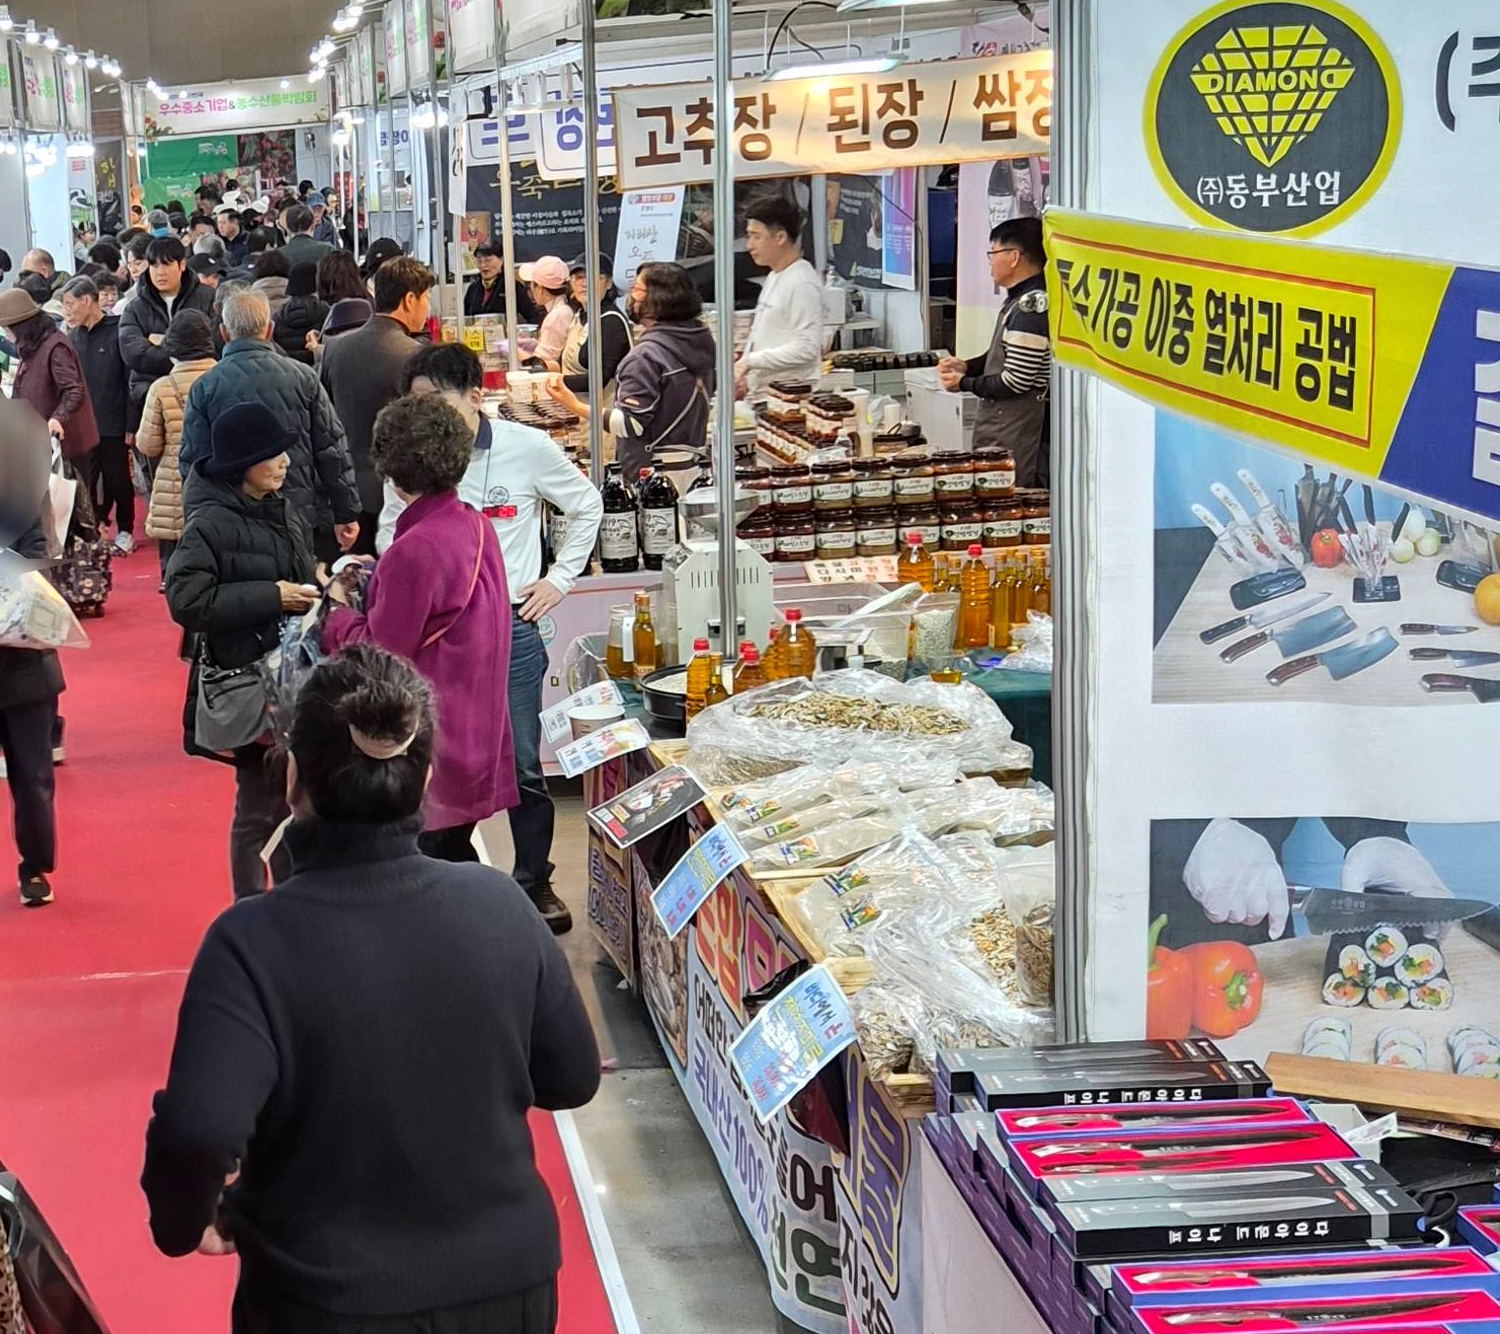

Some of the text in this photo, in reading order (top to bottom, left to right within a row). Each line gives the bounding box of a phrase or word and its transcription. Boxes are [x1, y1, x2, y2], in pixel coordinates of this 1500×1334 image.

[826, 78, 924, 153] 된장
[1196, 170, 1341, 209] (주)동부산업
[1145, 276, 1194, 366] 이중
[1202, 288, 1283, 391] 열처리
[1294, 305, 1357, 412] 공법
